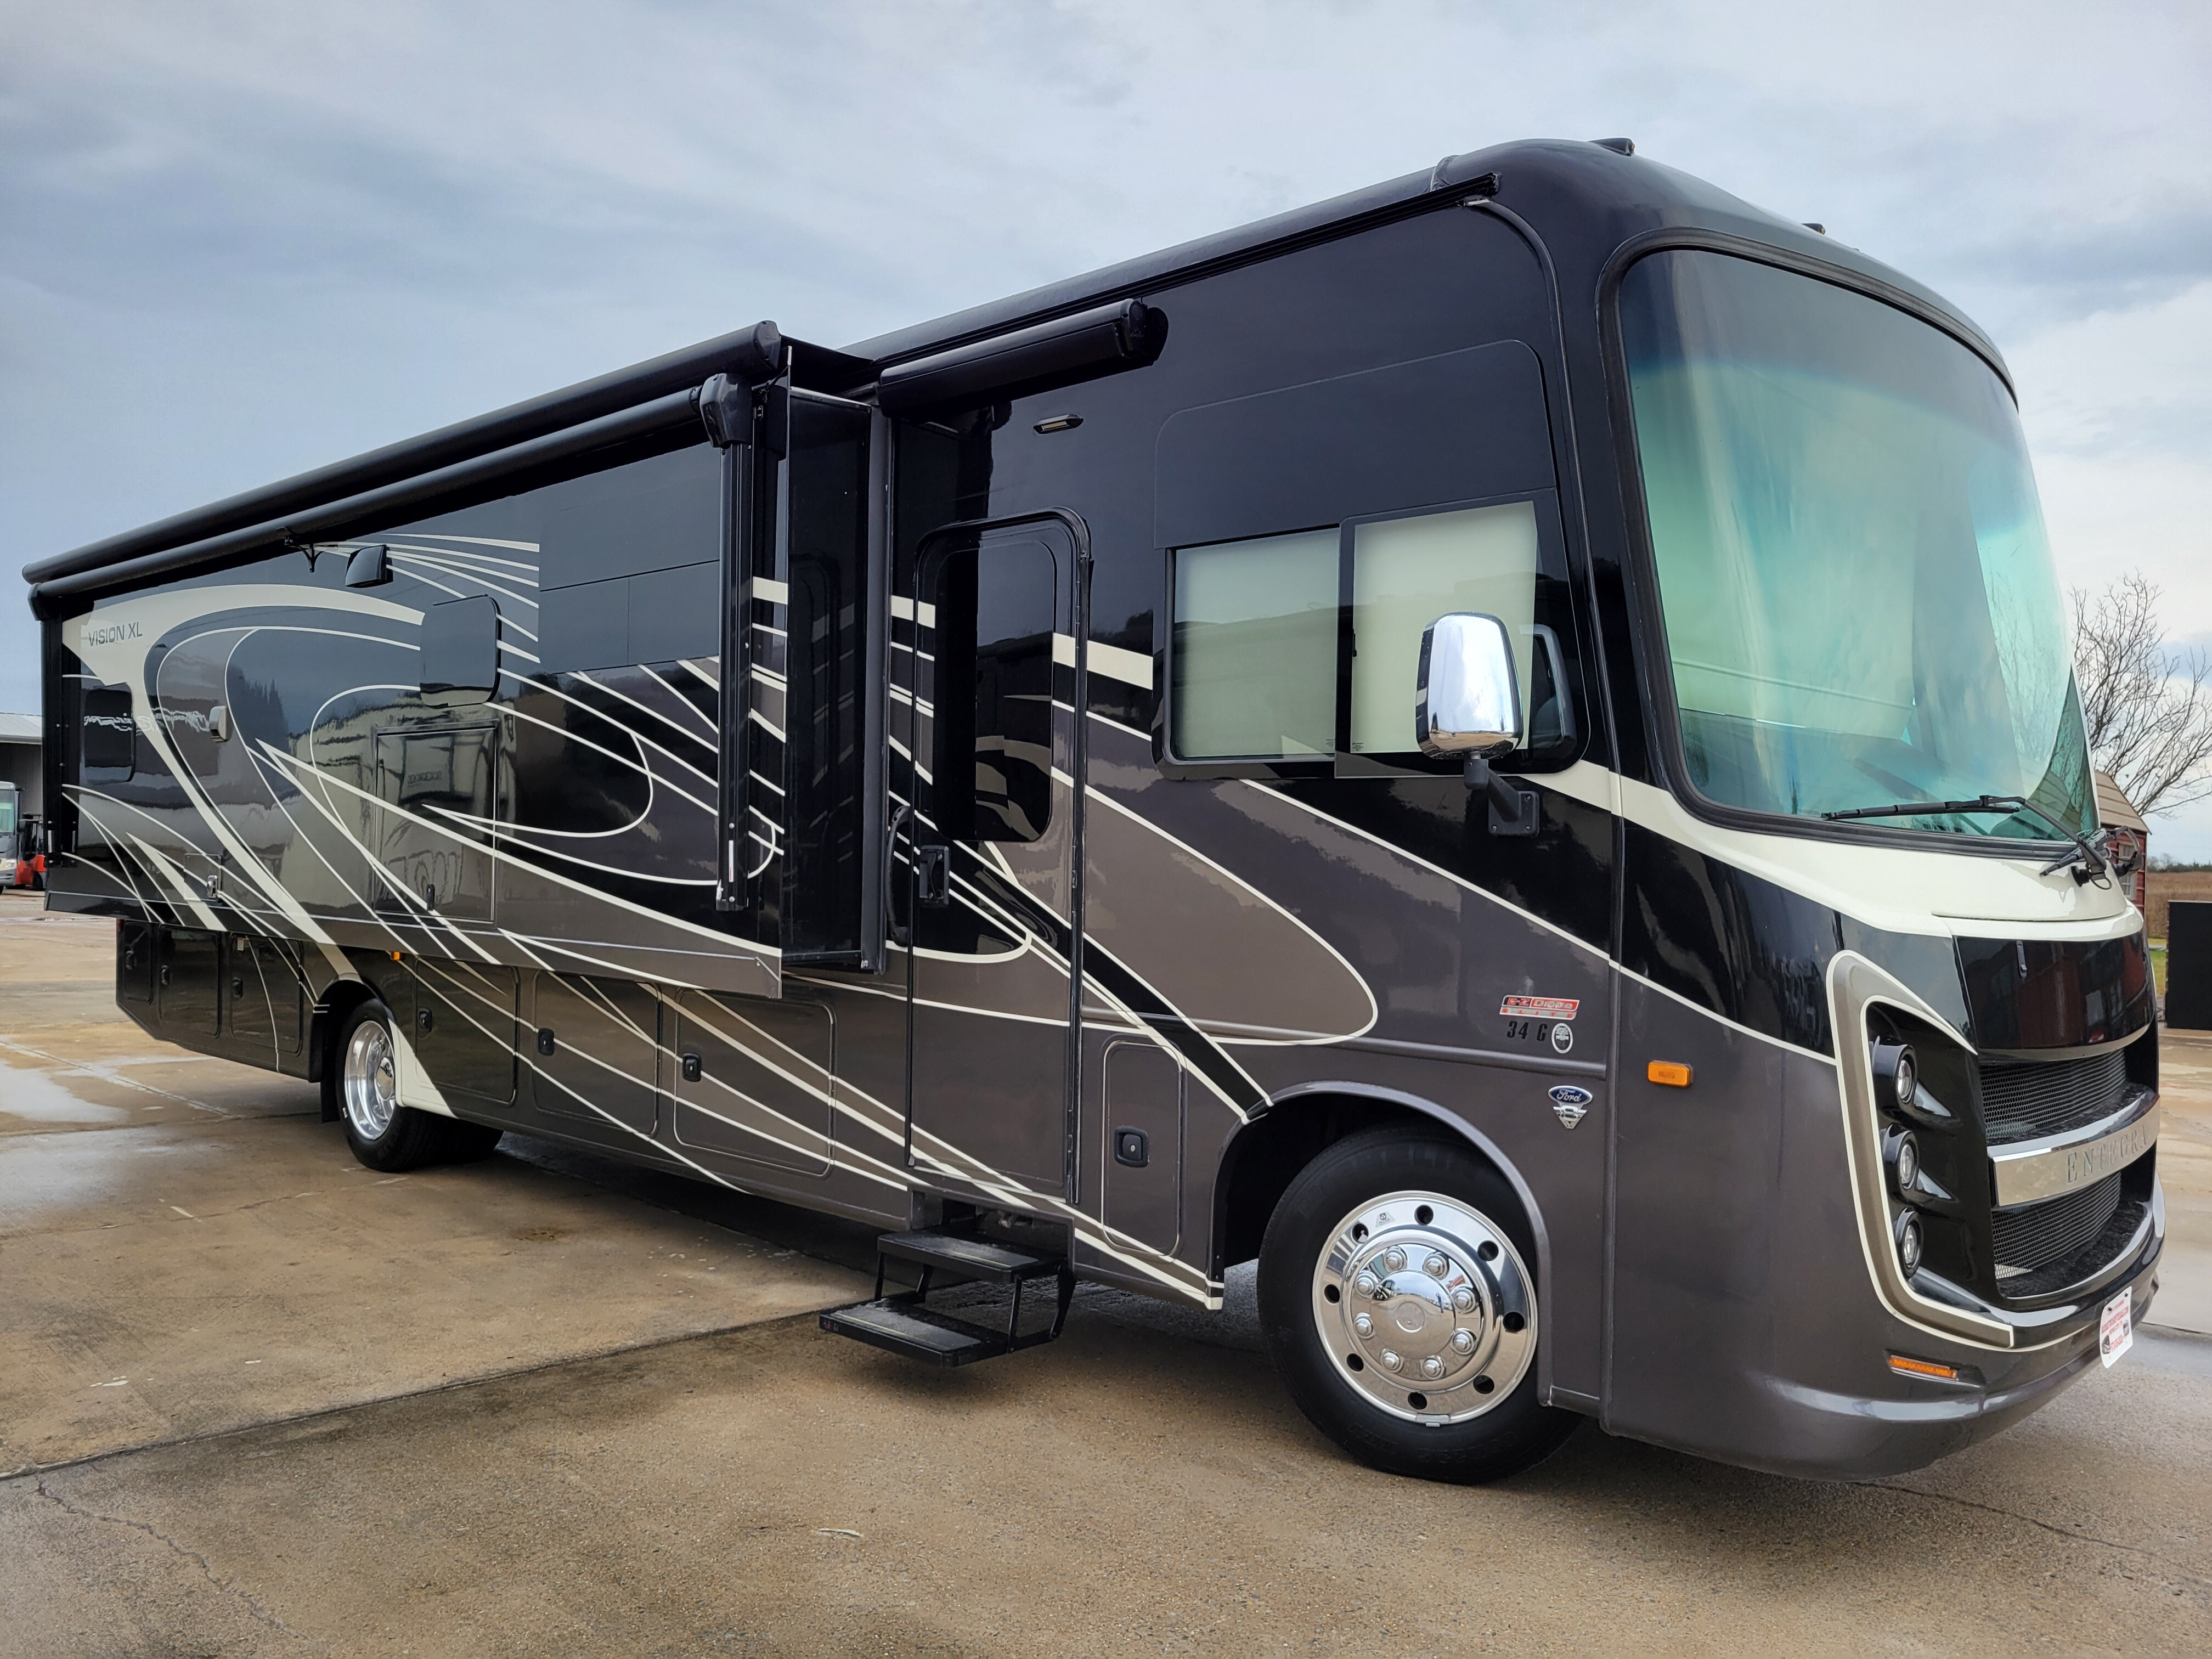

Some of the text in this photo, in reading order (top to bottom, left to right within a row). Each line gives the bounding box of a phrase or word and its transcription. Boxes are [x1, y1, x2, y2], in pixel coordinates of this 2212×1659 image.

[88, 622, 143, 646] VISION XL
[1507, 997, 1573, 1009] E-Z Drive
[1502, 1008, 1573, 1018] ELITE
[1506, 1020, 1530, 1040] 34
[1556, 1088, 1582, 1102] Ford
[2067, 1125, 2147, 1183] ENTEGRA
